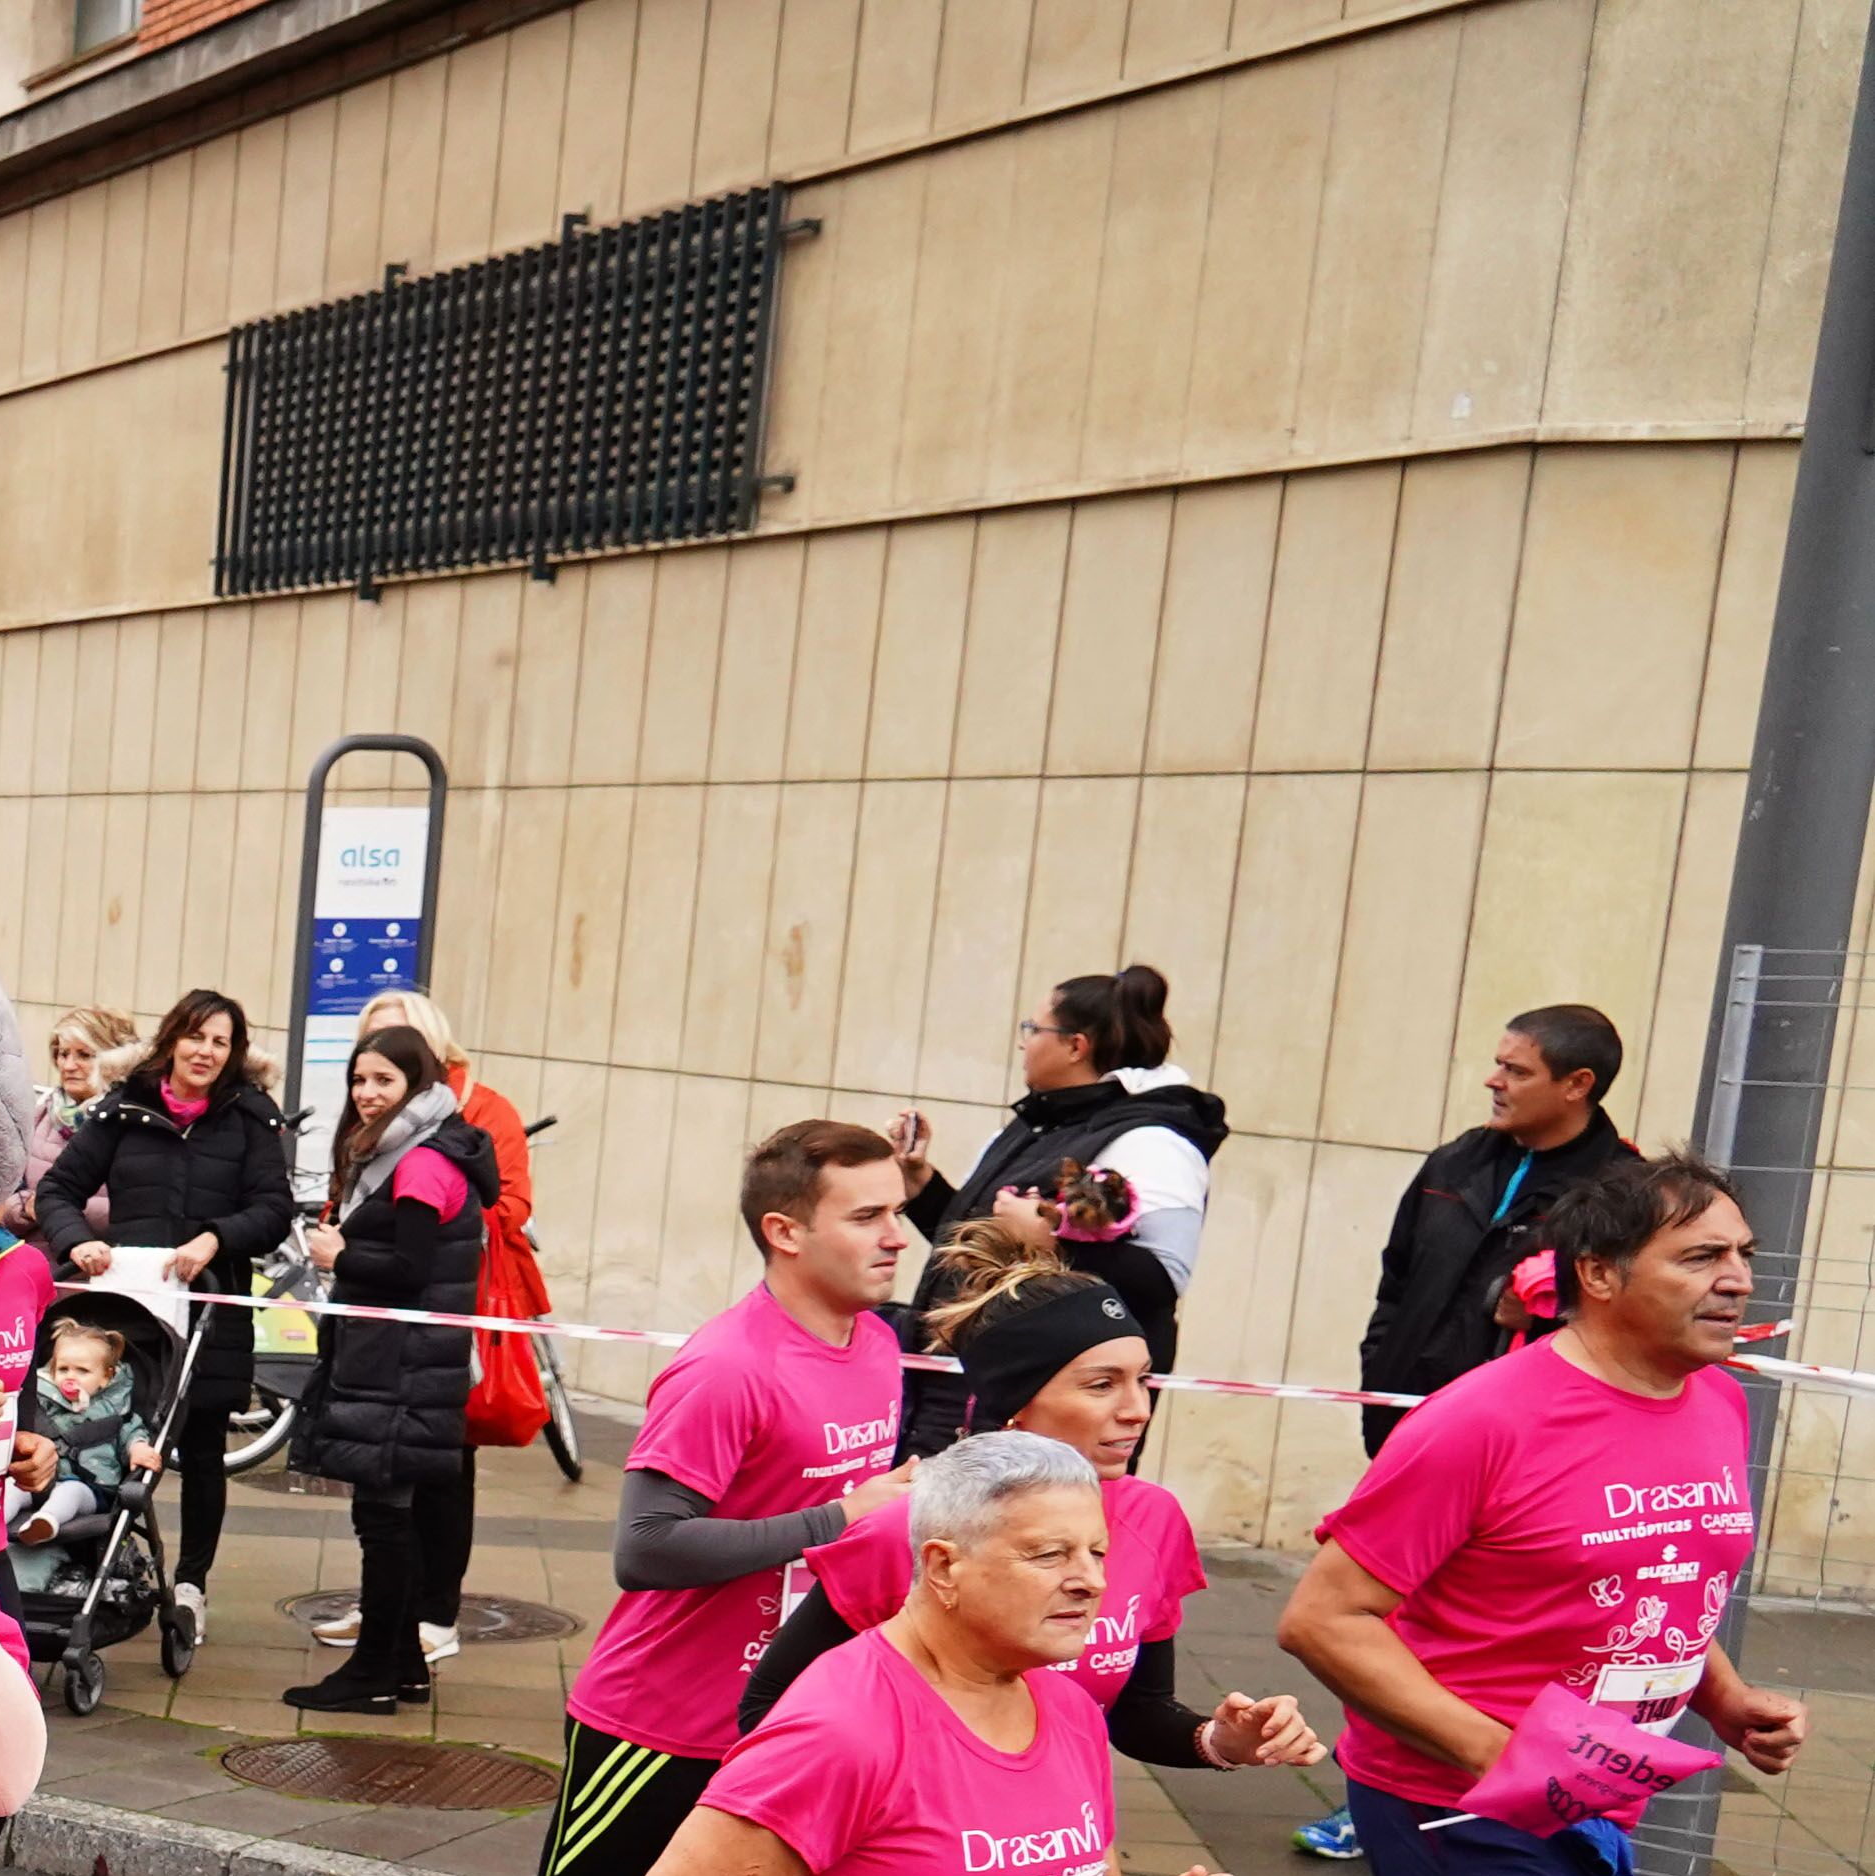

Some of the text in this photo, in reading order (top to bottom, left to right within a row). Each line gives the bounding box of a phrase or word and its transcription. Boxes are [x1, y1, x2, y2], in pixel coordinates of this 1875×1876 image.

[340, 845, 400, 867] alsa
[1636, 1561, 1700, 1581] SUZUKI
[961, 1801, 1102, 1872] Drasanvi
